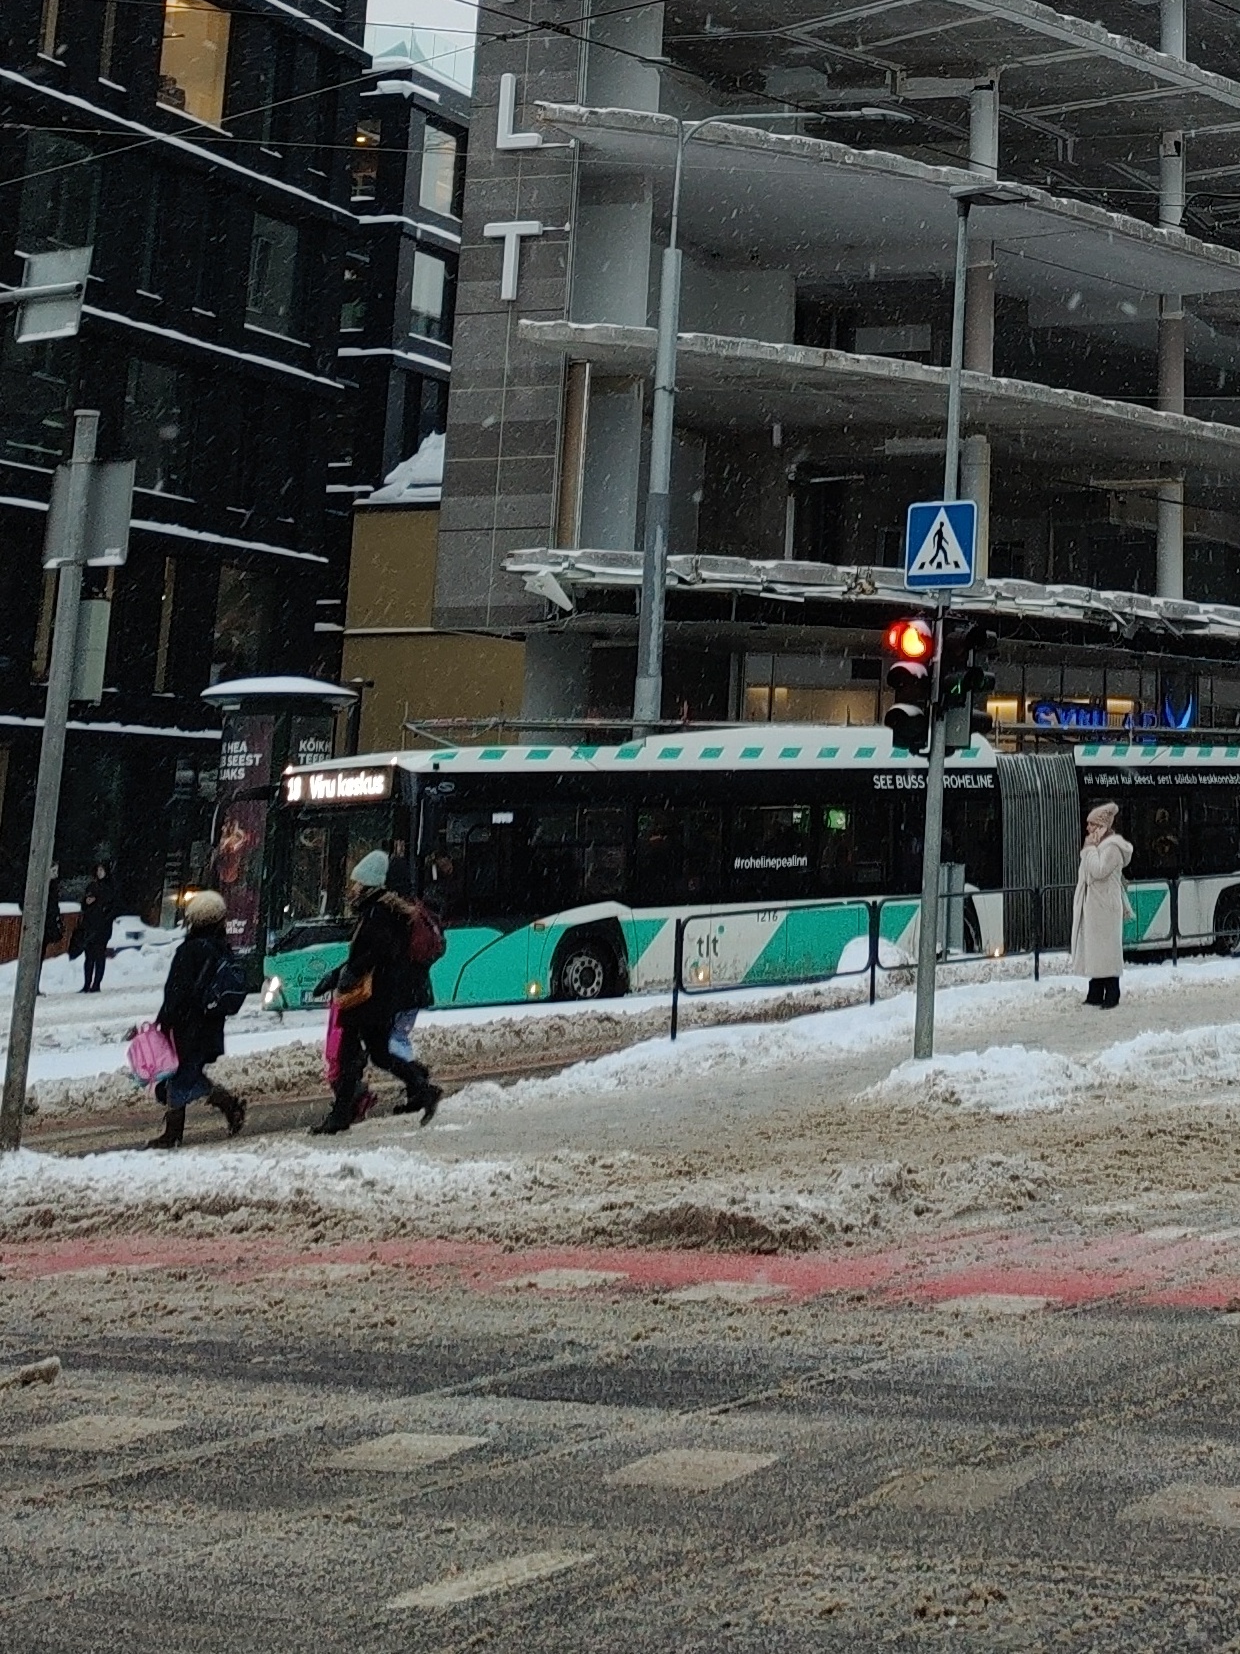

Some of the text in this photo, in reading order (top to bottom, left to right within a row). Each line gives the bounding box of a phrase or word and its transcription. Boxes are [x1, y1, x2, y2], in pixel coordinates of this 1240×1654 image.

[227, 740, 248, 754] HEA
[226, 753, 263, 767] SEEST
[309, 774, 336, 800] Viru
[337, 771, 384, 798] keskus
[873, 775, 894, 789] SEE
[896, 775, 925, 789] BUSS
[942, 774, 995, 789] ROHELINE
[734, 854, 808, 871] #rohelinepealinn
